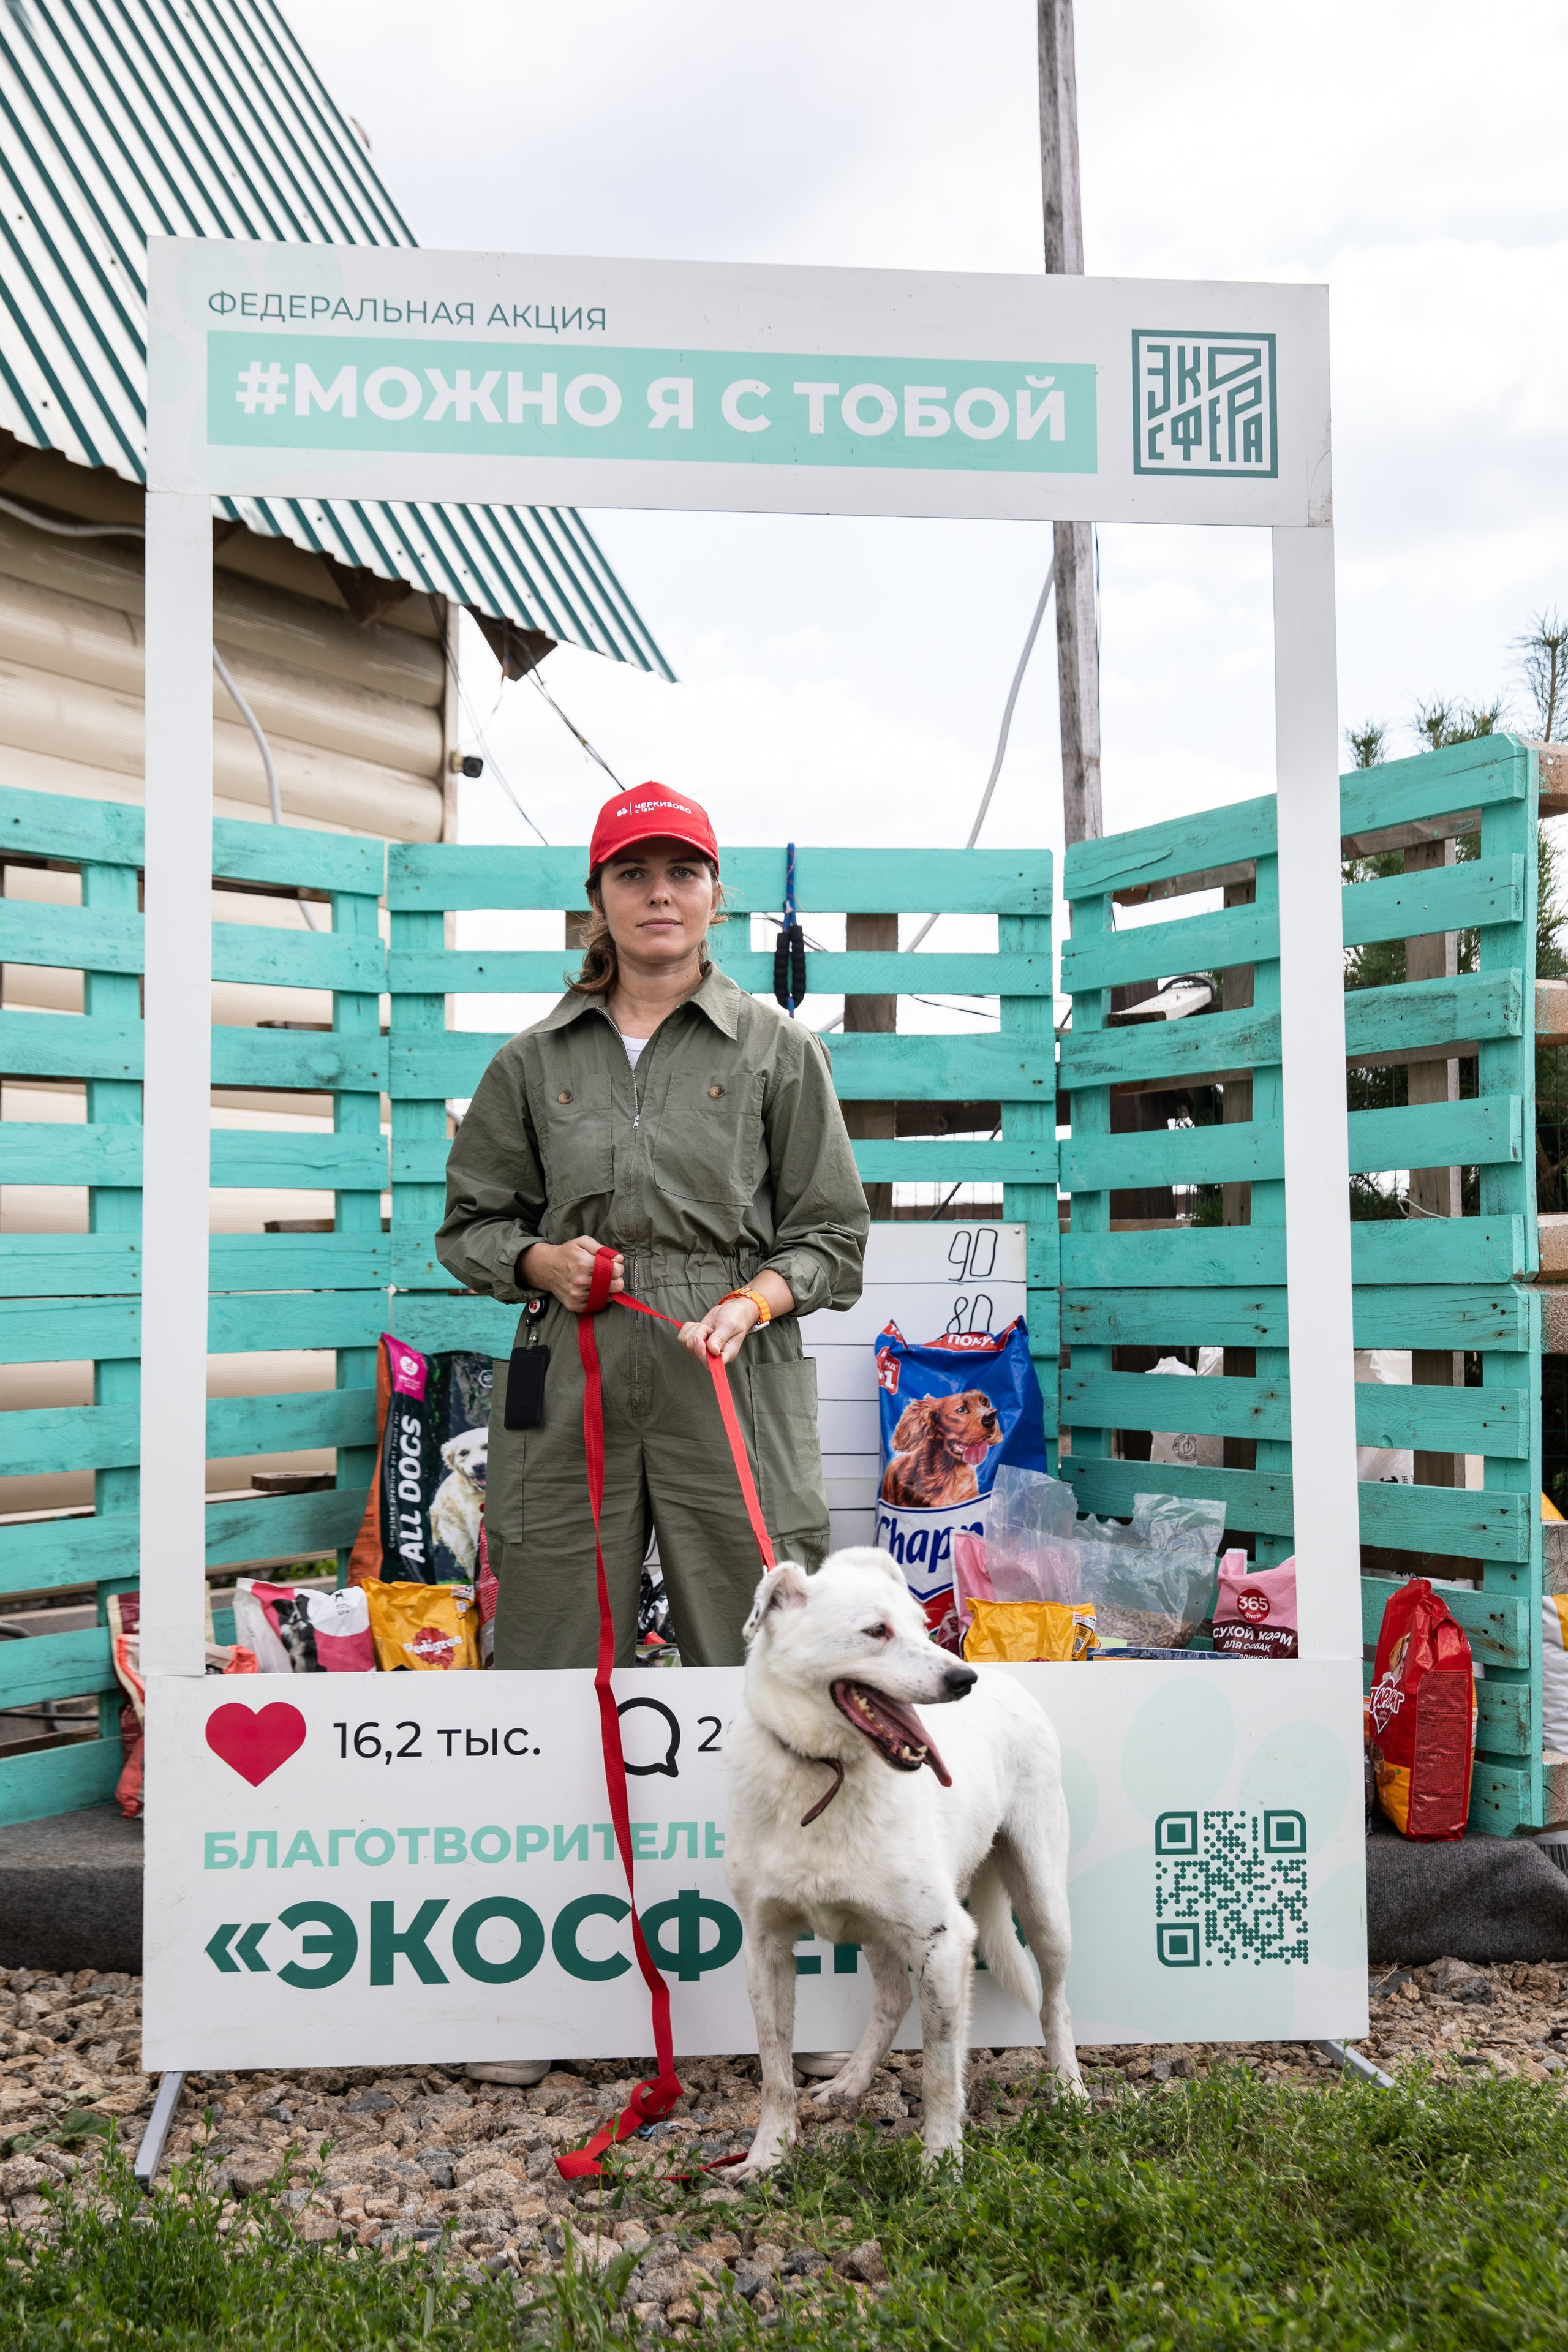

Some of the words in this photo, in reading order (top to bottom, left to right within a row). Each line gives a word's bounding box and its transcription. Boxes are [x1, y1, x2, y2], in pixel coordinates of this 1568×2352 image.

[208, 290, 475, 326] ФЕДЕРАЛЬНАЯ
[486, 303, 606, 334] АКЦИЯ
[235, 360, 622, 425] #МОЖНО
[647, 377, 694, 429] Я
[721, 379, 772, 433] С
[793, 375, 1065, 442] ТОБОЙ
[635, 801, 692, 814] ЧЕРКИЗОВО
[948, 1228, 998, 1281] 90
[946, 1294, 993, 1333] 80
[948, 1333, 995, 1347] ПОКУ
[398, 1415, 422, 1503] DOGS
[399, 1510, 426, 1564] ALL
[876, 1514, 991, 1573] Chap
[1238, 1595, 1268, 1611] 365
[402, 1636, 463, 1655] Pedigree
[1213, 1626, 1254, 1640] СУХОЙ
[1257, 1631, 1294, 1646] КОРМ
[1223, 1640, 1242, 1649] ДЛЯ
[1243, 1642, 1272, 1653] СОБАК
[333, 1721, 423, 1766] 16,2
[437, 1727, 541, 1757] тыс.
